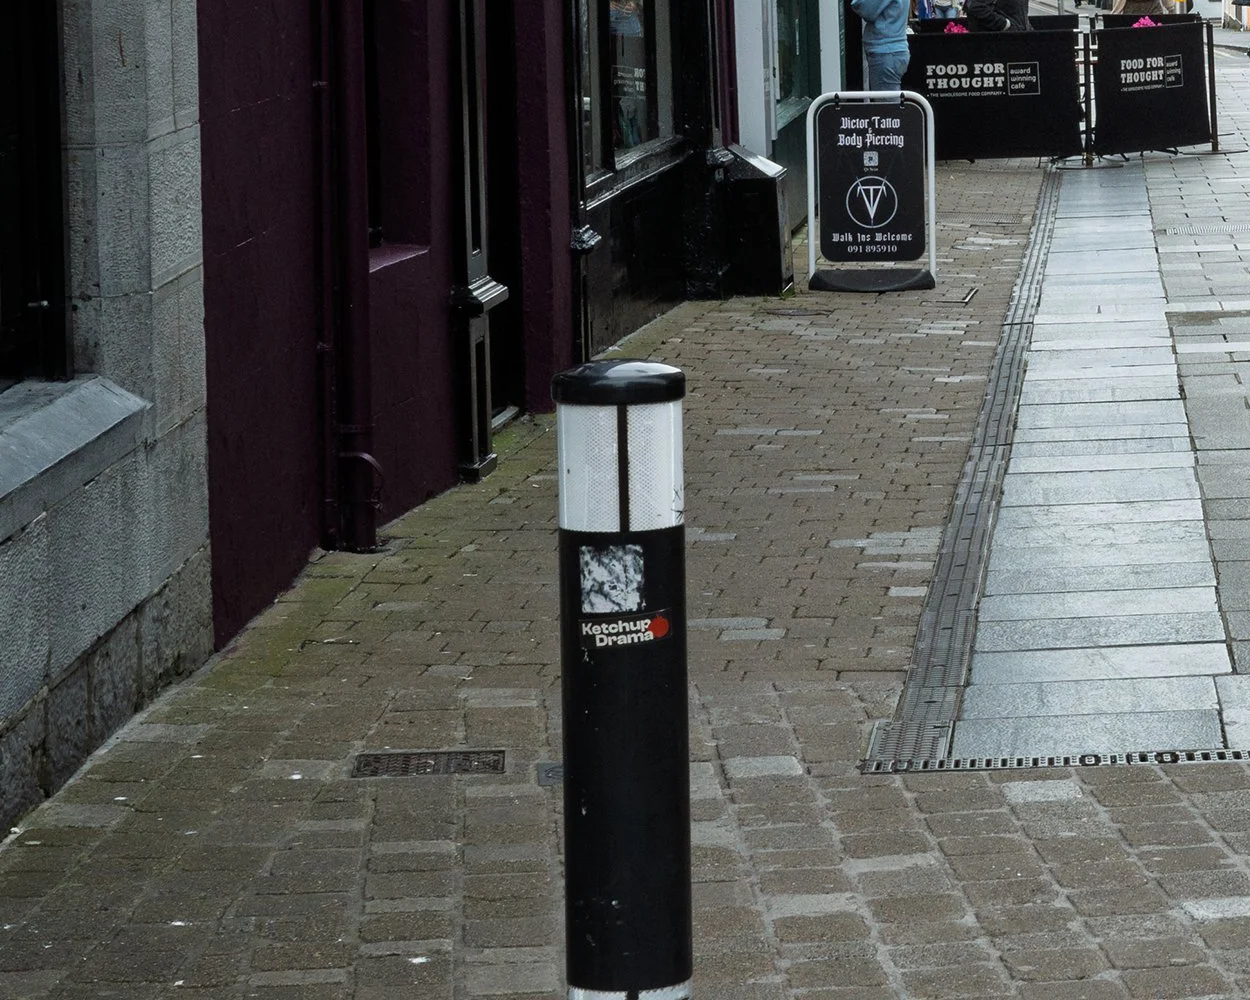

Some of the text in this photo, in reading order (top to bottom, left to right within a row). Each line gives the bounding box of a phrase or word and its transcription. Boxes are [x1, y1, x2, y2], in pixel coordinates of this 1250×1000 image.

[926, 62, 1005, 76] FOOD FOR
[1120, 56, 1164, 70] FOOD FOR
[1009, 67, 1031, 75] award
[1120, 69, 1164, 83] THOUGHT
[926, 76, 1005, 89] THOUGHT
[1010, 82, 1026, 90] café
[840, 116, 870, 129] Victor
[837, 132, 904, 148] Body Piercing
[832, 232, 913, 243] Walk Ins Welcome
[847, 244, 898, 253] 091 895910
[581, 617, 651, 636] Ketchup
[595, 630, 655, 647] Drama
